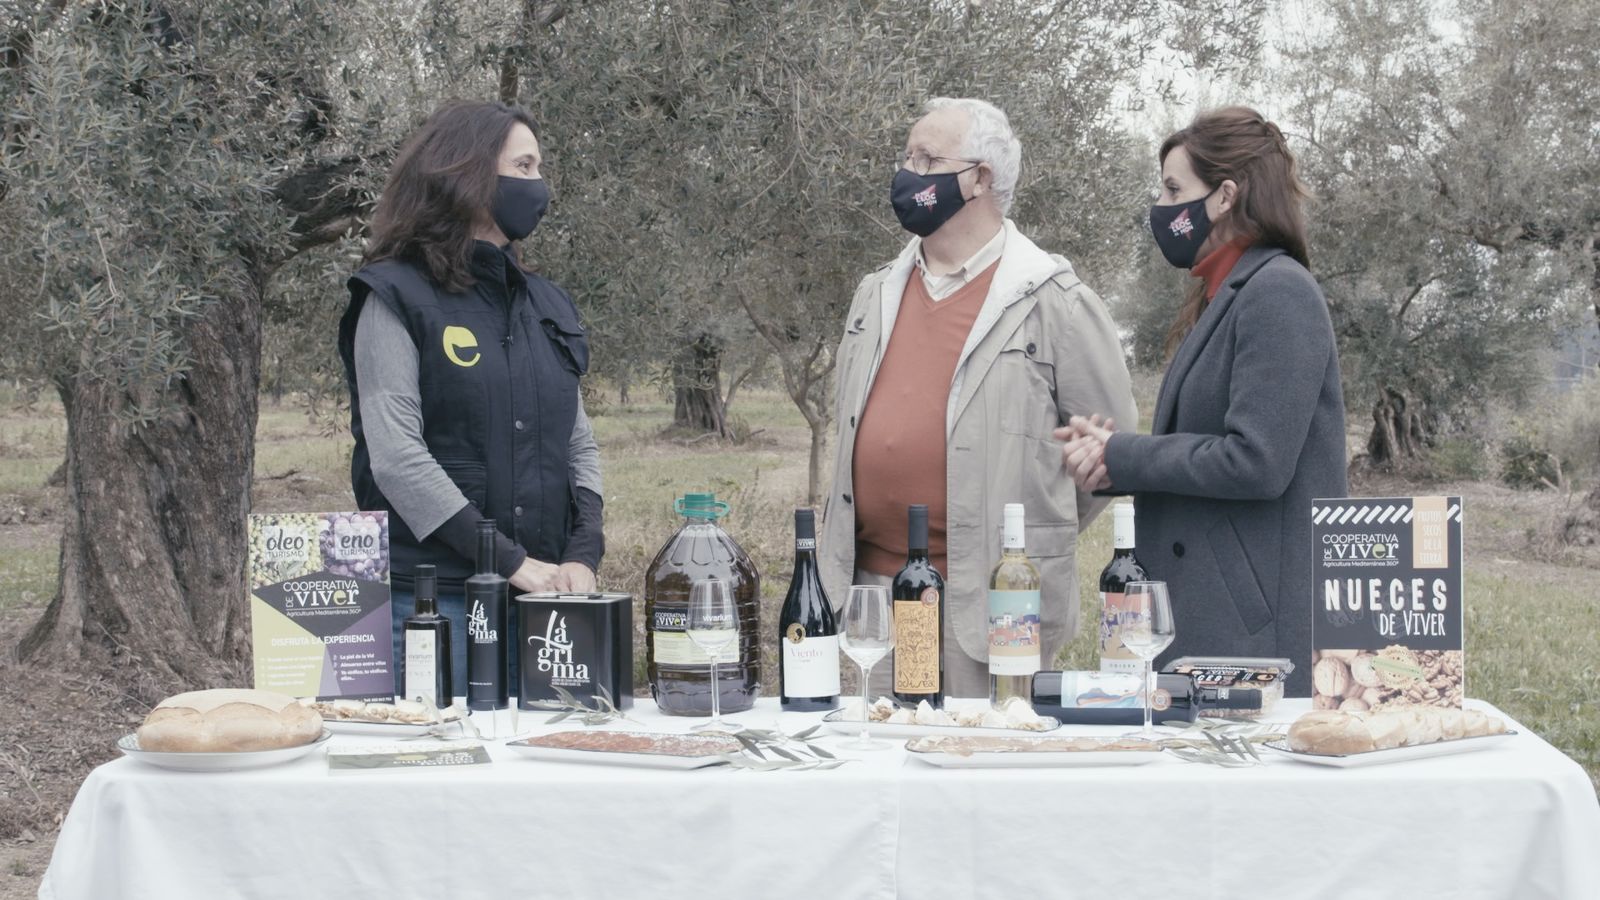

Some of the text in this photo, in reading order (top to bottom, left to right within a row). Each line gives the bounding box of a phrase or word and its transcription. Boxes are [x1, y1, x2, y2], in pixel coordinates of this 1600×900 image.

[1423, 524, 1442, 536] SECOS
[266, 528, 304, 551] oleo
[341, 534, 374, 549] eno
[1322, 533, 1399, 544] COOPERATIVA
[268, 550, 304, 558] TURISMO
[1333, 543, 1399, 559] viver
[283, 580, 359, 592] COOPERATIVA
[294, 590, 359, 607] viver
[1325, 578, 1448, 611] NUECES
[271, 634, 375, 646] DISFRUTA LA EXPERIENCIA
